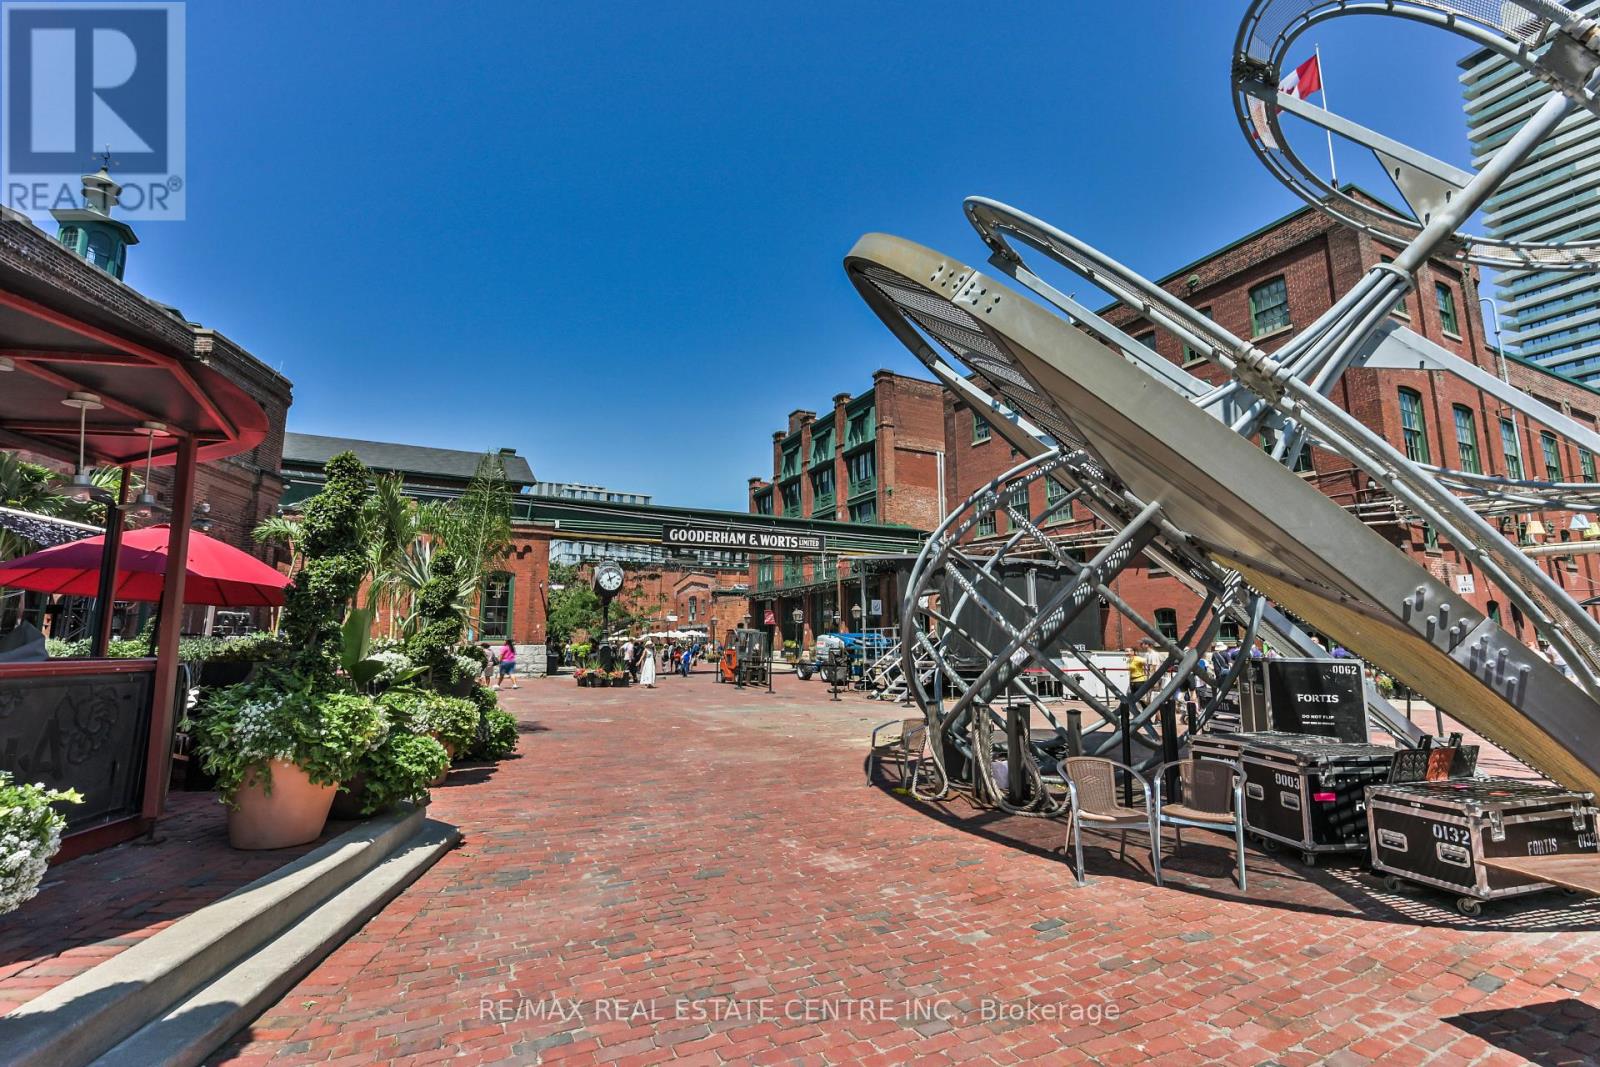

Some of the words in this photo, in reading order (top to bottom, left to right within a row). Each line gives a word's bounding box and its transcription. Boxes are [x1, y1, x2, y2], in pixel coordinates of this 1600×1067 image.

[669, 528, 746, 545] GOODERHAM
[749, 534, 758, 546] &
[760, 534, 798, 548] WORTS
[1332, 665, 1357, 675] 0062
[1297, 693, 1339, 703] FORTIS
[1275, 773, 1300, 790] 0003
[1433, 824, 1470, 845] 0132
[1527, 838, 1558, 856] FORTIS
[1578, 832, 1597, 848] 0132
